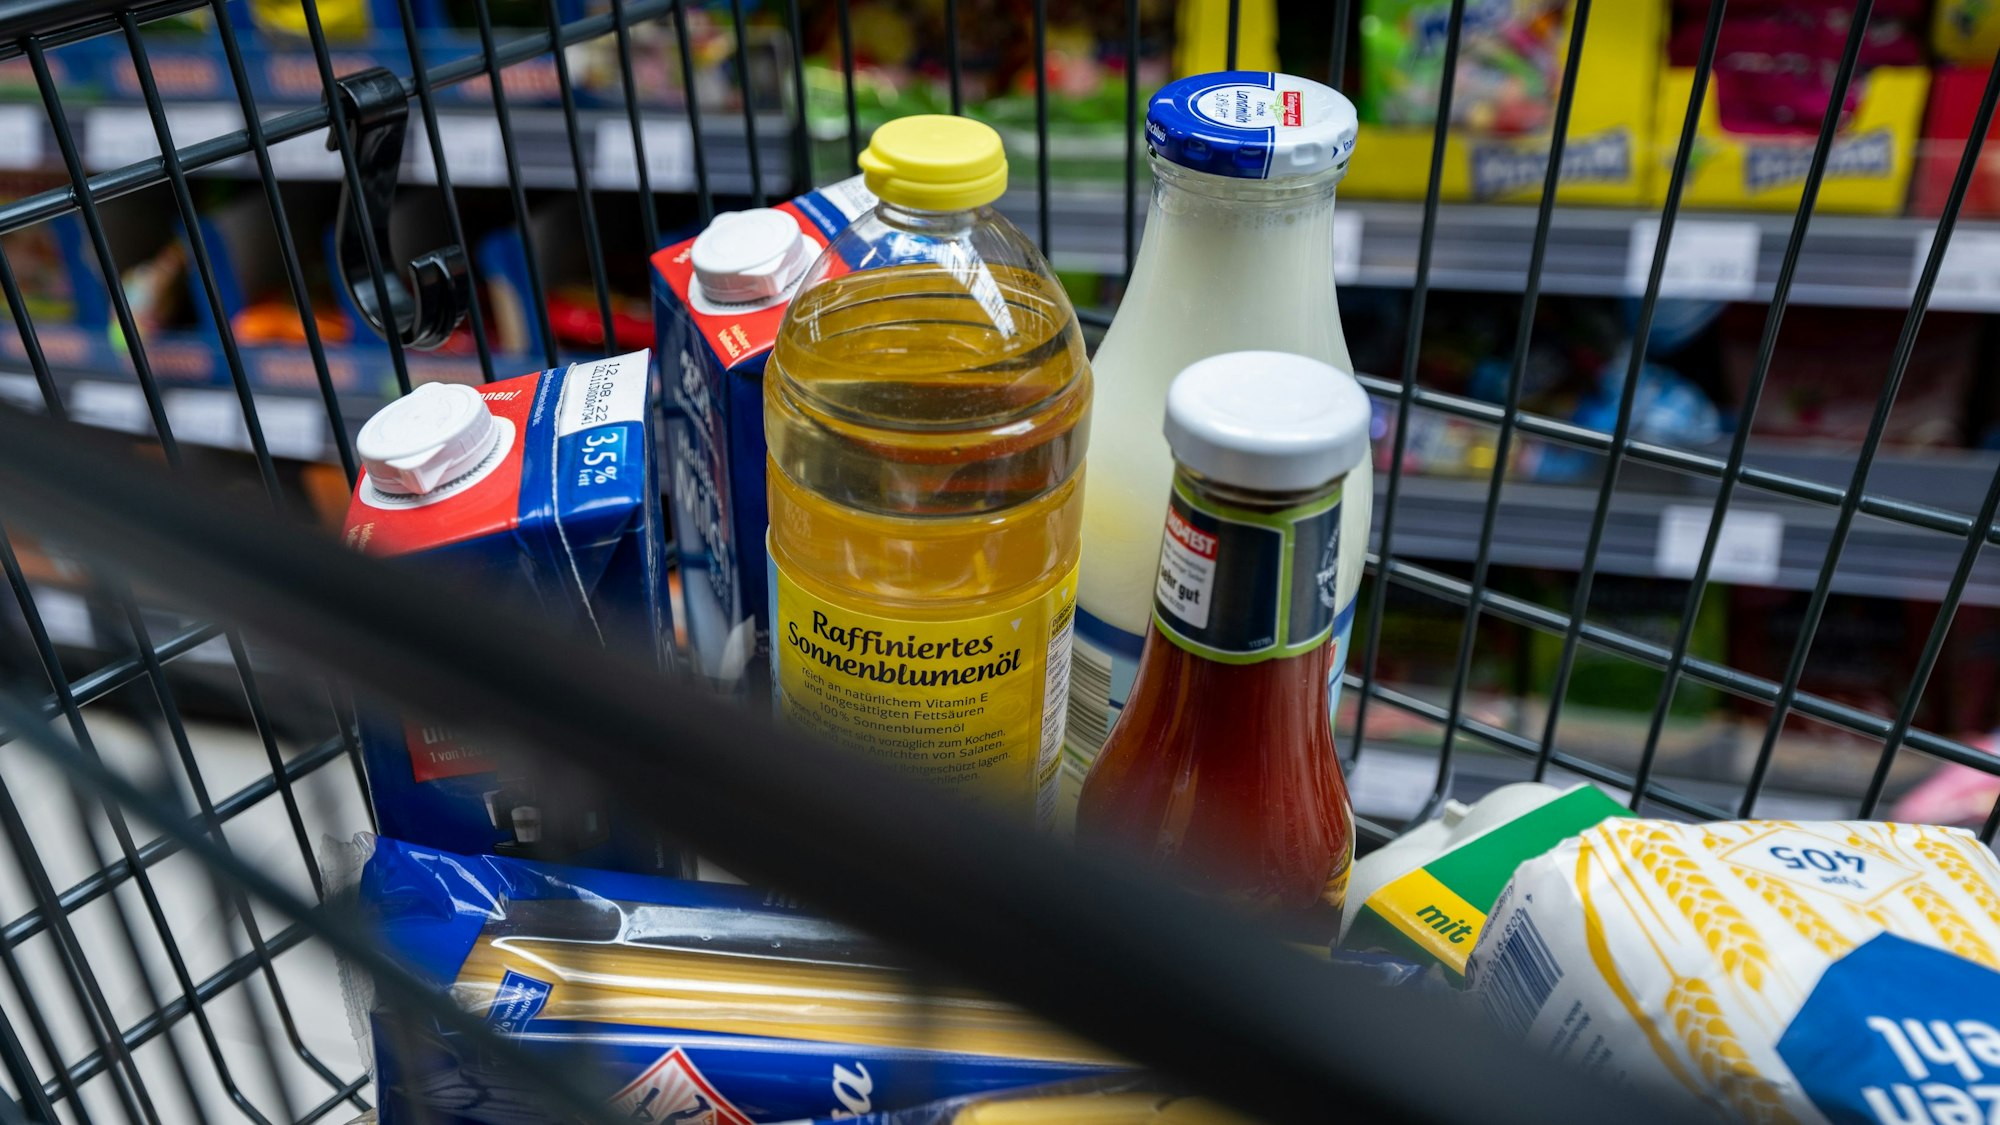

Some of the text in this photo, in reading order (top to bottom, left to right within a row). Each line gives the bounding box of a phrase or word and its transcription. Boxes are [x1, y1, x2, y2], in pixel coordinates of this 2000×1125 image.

[1235, 90, 1250, 123] Landmilch
[595, 362, 620, 423] 12.08.22
[581, 431, 619, 484] 3,5%
[1178, 581, 1200, 605] gut
[788, 621, 1022, 686] Sonnenblumenöl
[812, 610, 994, 660] Raffiniertes
[801, 665, 990, 710] reich an natürlichem Vitamin E
[804, 679, 986, 721] und ungesättigten Fettsäuren
[819, 702, 966, 736] 100% Sonnenblumenöl
[855, 730, 877, 745] sich
[878, 733, 936, 752] vorzüglich
[938, 737, 962, 749] zum
[868, 744, 929, 762] Anrichten
[932, 749, 956, 761] von
[1768, 845, 1868, 875] 405
[1415, 903, 1473, 945] mit
